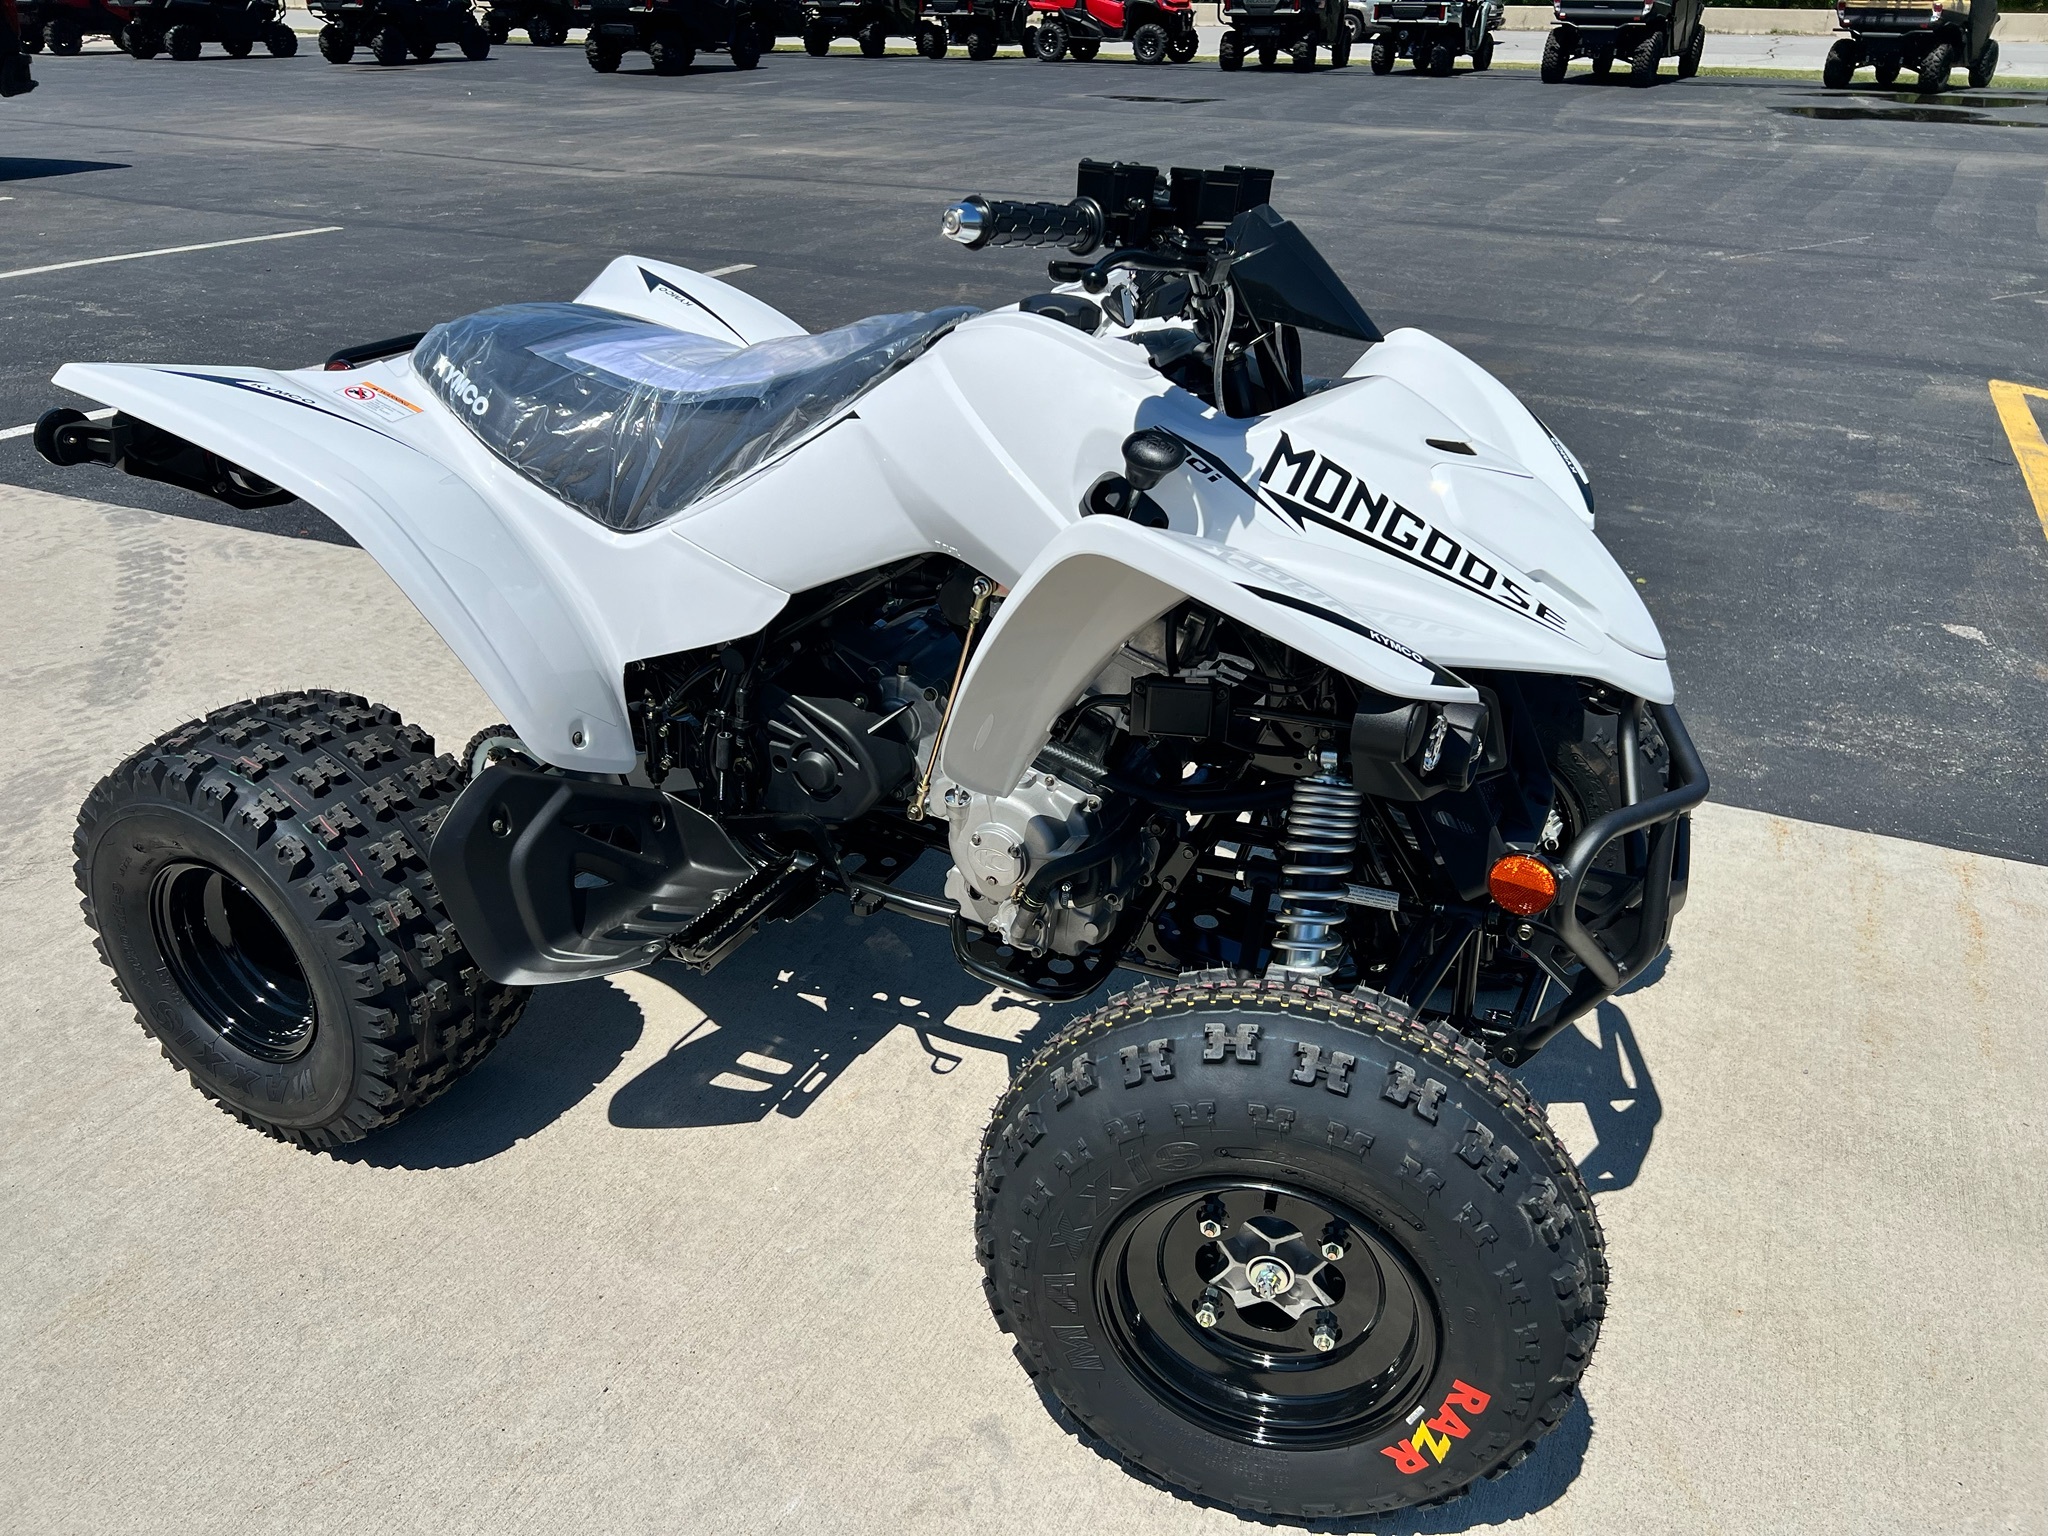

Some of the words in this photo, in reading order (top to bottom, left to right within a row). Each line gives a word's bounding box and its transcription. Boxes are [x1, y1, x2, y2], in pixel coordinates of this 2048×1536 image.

[250, 383, 316, 404] KYMCO
[432, 352, 489, 416] KYMCO
[1258, 429, 1567, 631] MONGOOSE
[1369, 630, 1423, 663] KYMCO
[1042, 1140, 1203, 1371] MAXXIS
[1380, 1378, 1492, 1475] RAZR
